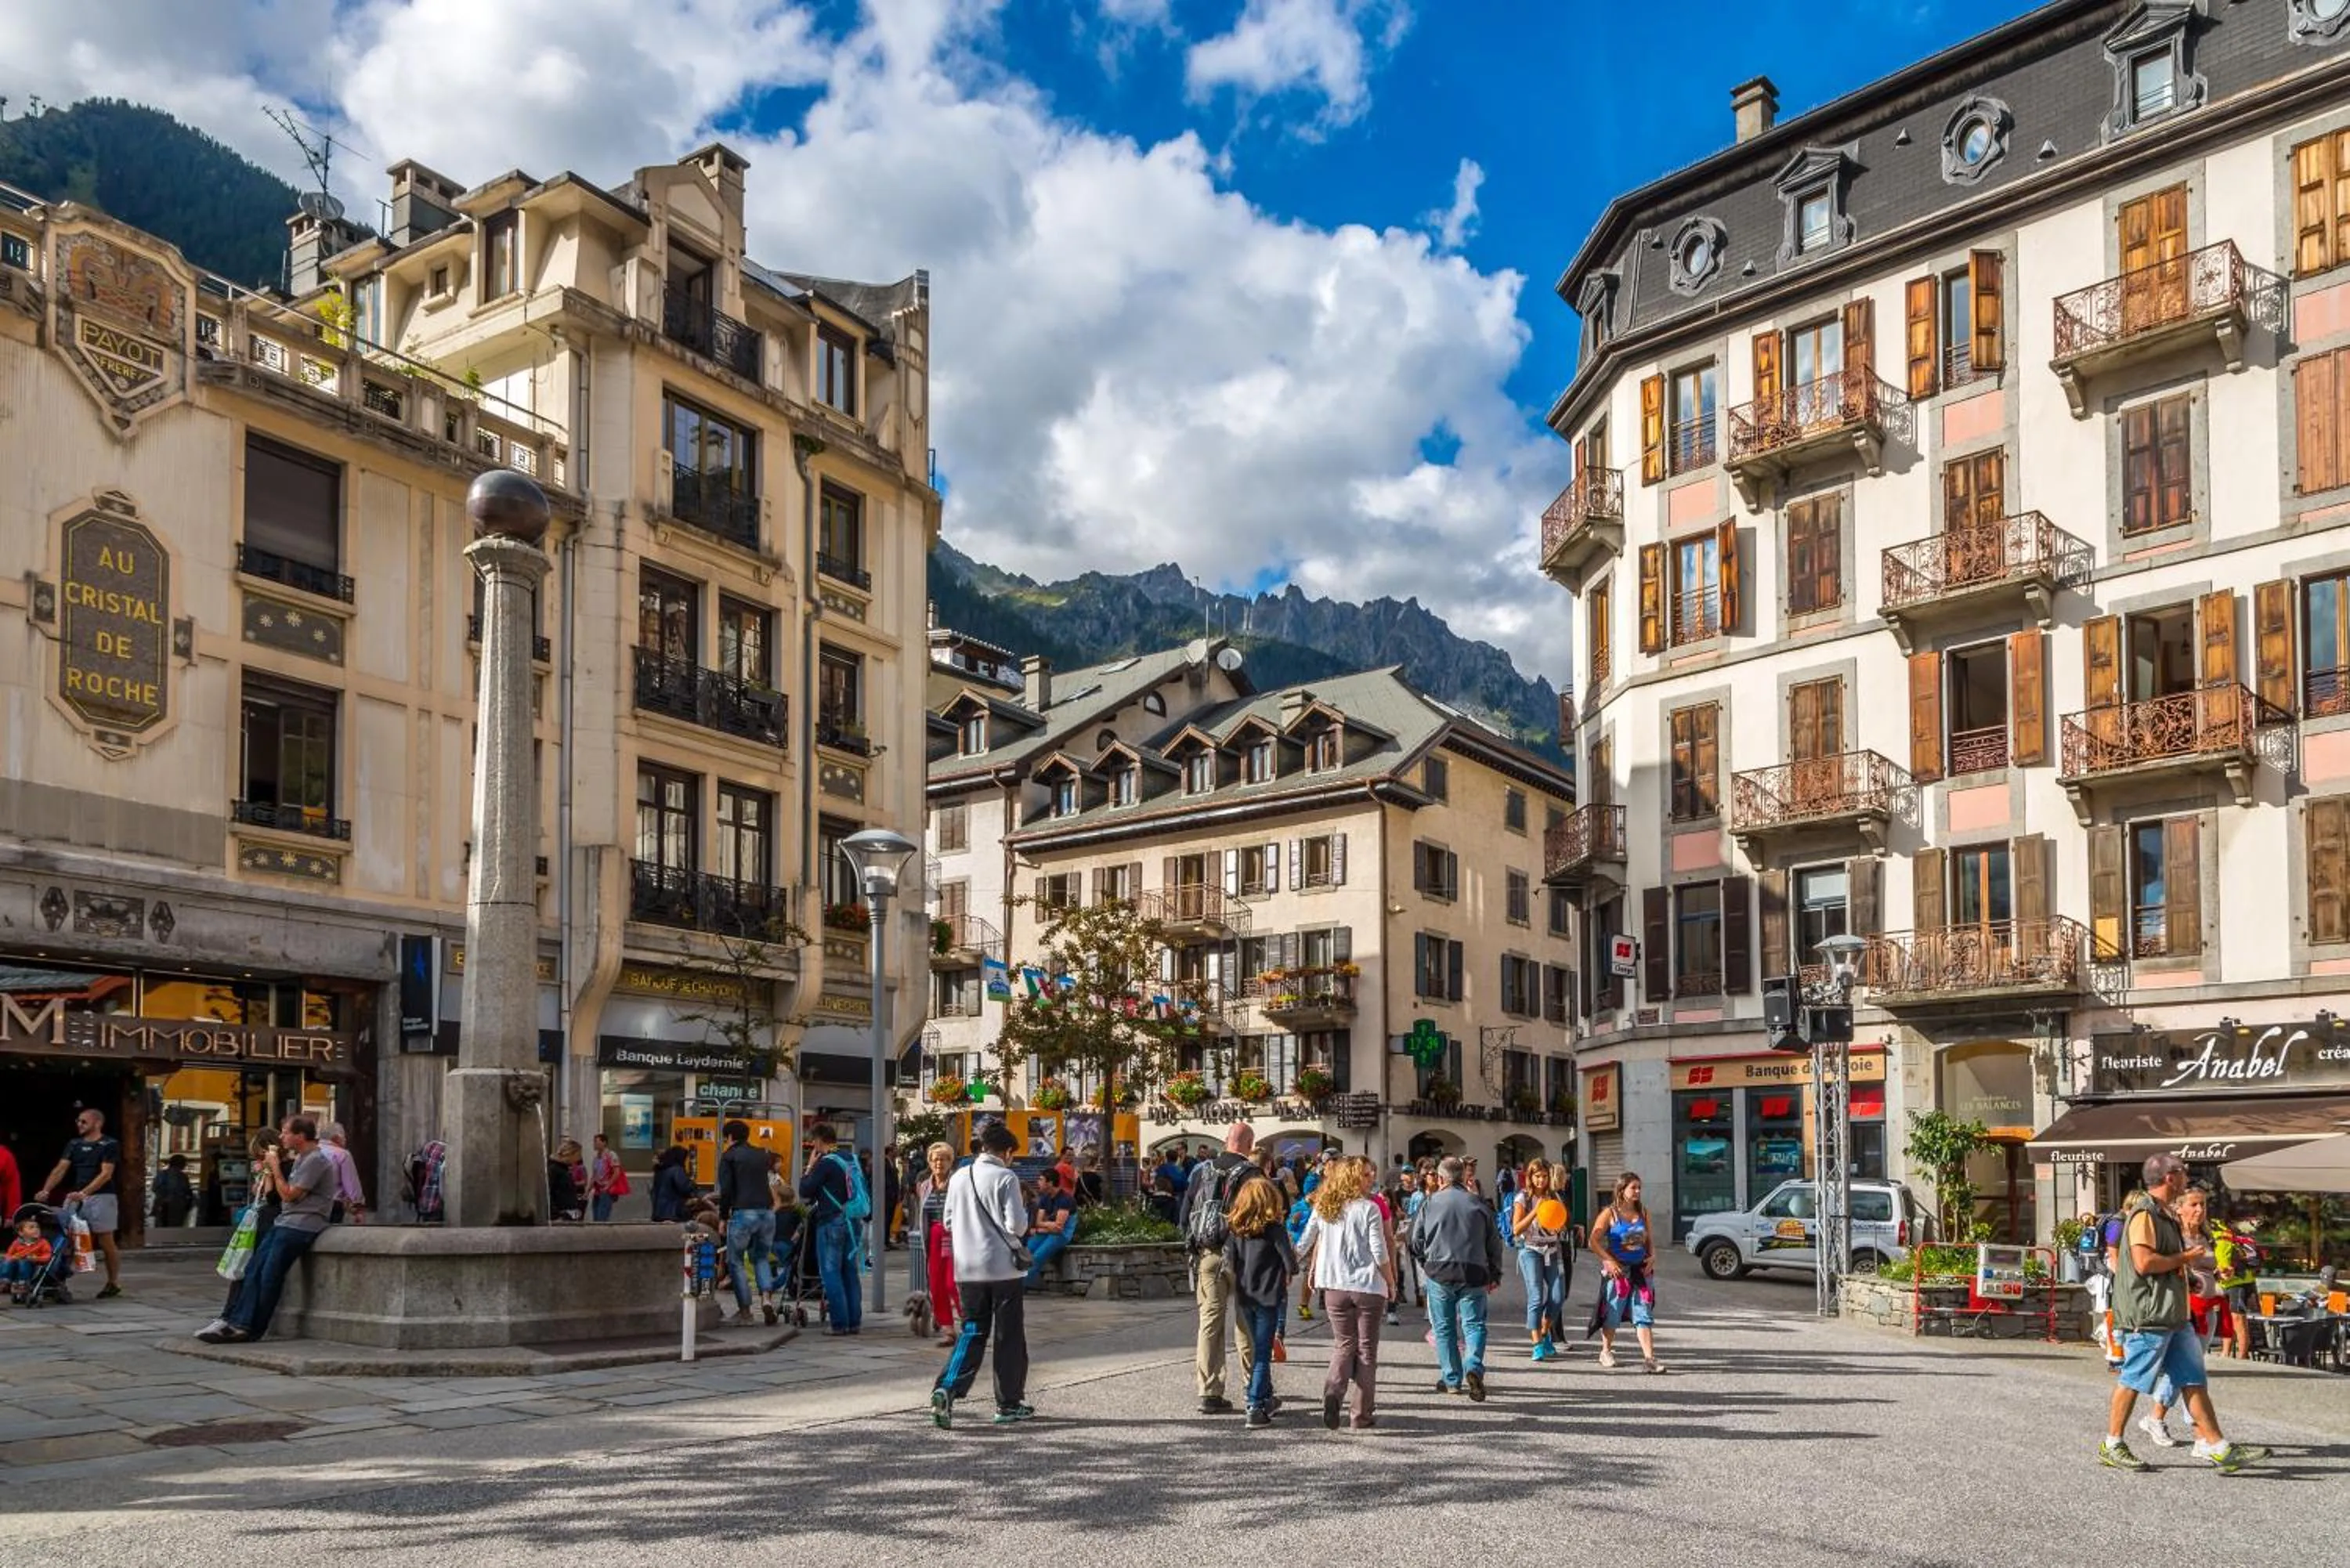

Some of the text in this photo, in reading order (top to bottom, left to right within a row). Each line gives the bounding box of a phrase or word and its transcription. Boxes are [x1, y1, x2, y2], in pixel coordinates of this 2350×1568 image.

[82, 322, 161, 370] PAYOT
[99, 545, 135, 574] AU
[65, 581, 164, 624] CRISTAL
[96, 630, 132, 659] DE
[67, 667, 158, 706] ROCHE
[101, 1021, 333, 1061] IMMOBILIER
[616, 1048, 674, 1065] Banque
[1745, 1063, 1798, 1078] Banque
[2101, 1054, 2163, 1070] fleuriste
[2160, 1027, 2309, 1087] Anabel
[1194, 1102, 1249, 1121] MONT
[2050, 1143, 2236, 1162] fleuriste Anabel
